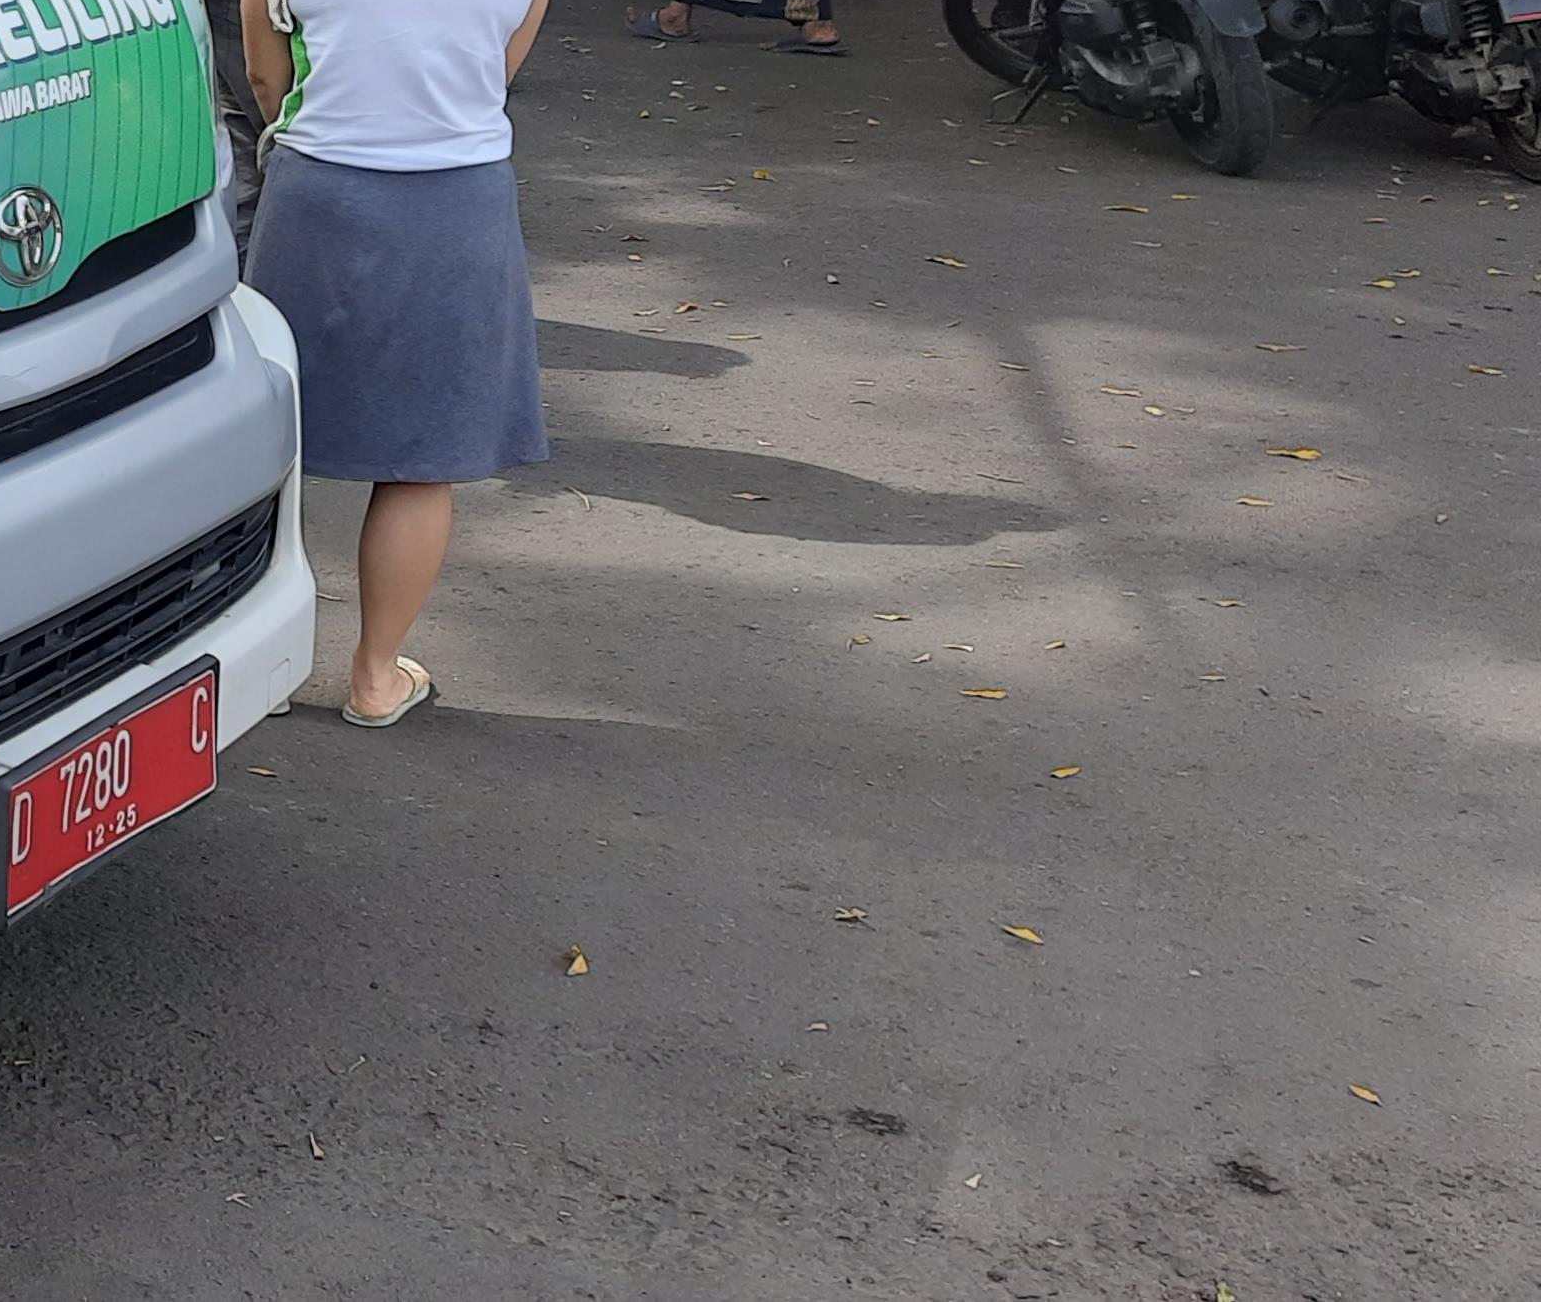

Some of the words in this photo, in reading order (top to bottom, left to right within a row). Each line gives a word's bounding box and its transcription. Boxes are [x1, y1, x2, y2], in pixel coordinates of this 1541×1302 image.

[34, 68, 92, 112] BARAT
[10, 790, 33, 866] D
[59, 729, 132, 834] 7280
[191, 685, 209, 754] C
